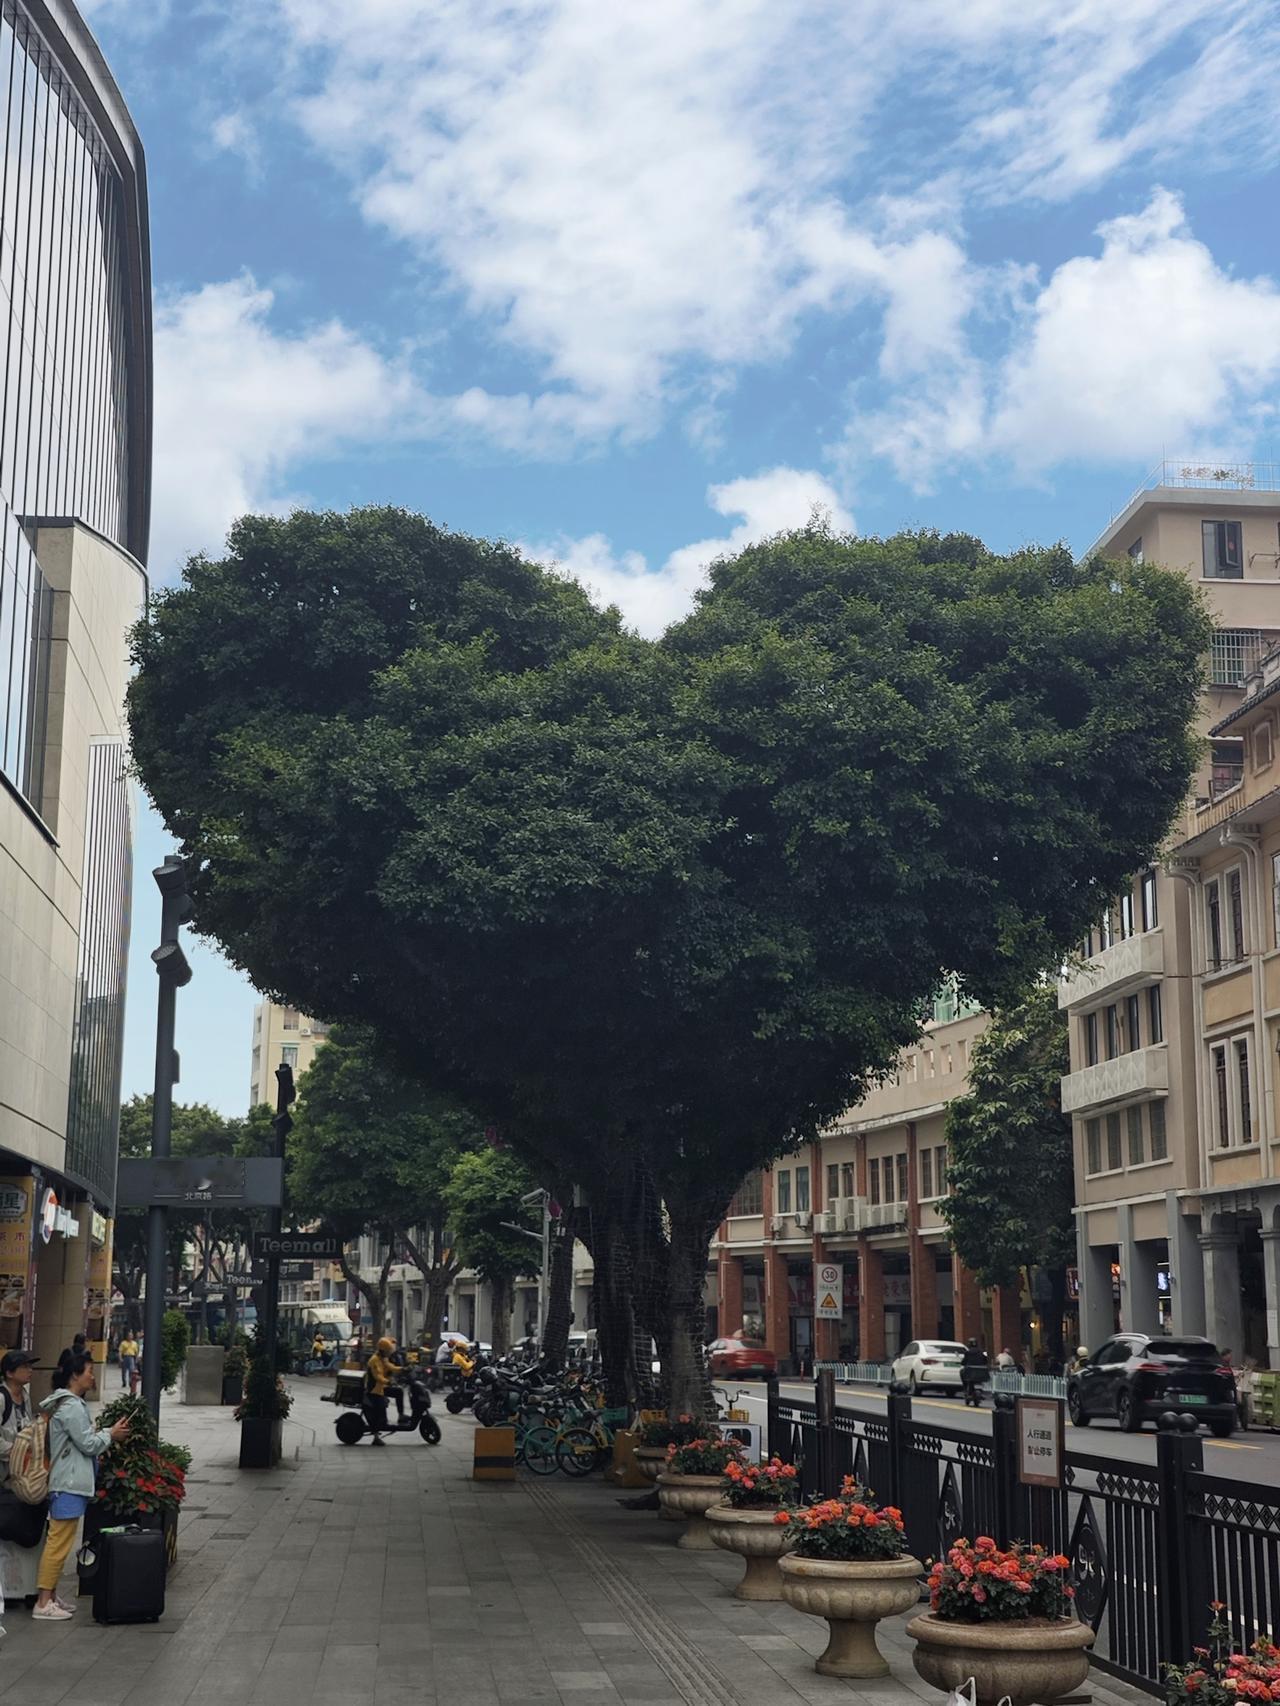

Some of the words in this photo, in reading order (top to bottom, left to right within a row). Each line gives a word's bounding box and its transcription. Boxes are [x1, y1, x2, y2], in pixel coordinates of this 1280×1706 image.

[184, 1191, 213, 1201] 北京路
[260, 1237, 337, 1253] Teemall
